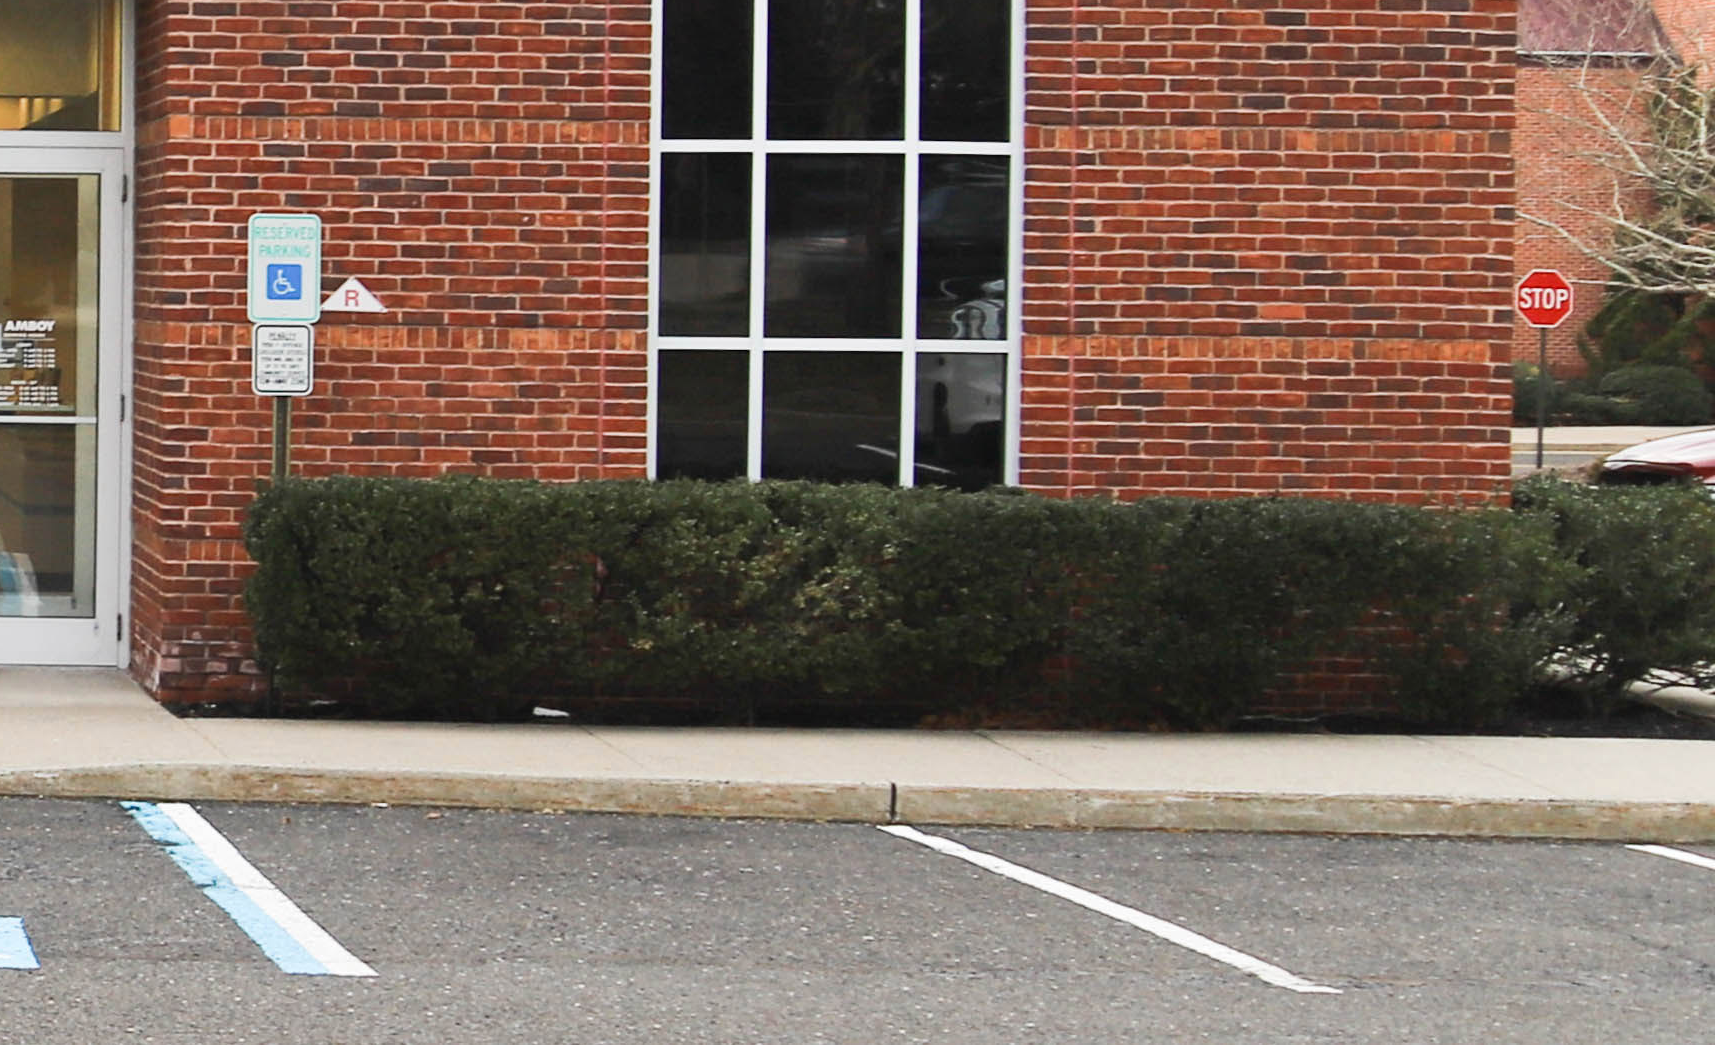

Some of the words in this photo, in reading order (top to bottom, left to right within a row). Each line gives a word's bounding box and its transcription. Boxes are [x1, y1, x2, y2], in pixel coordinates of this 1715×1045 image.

[345, 290, 359, 306] R
[1519, 287, 1569, 310] STOP
[4, 320, 56, 331] AMBOY
